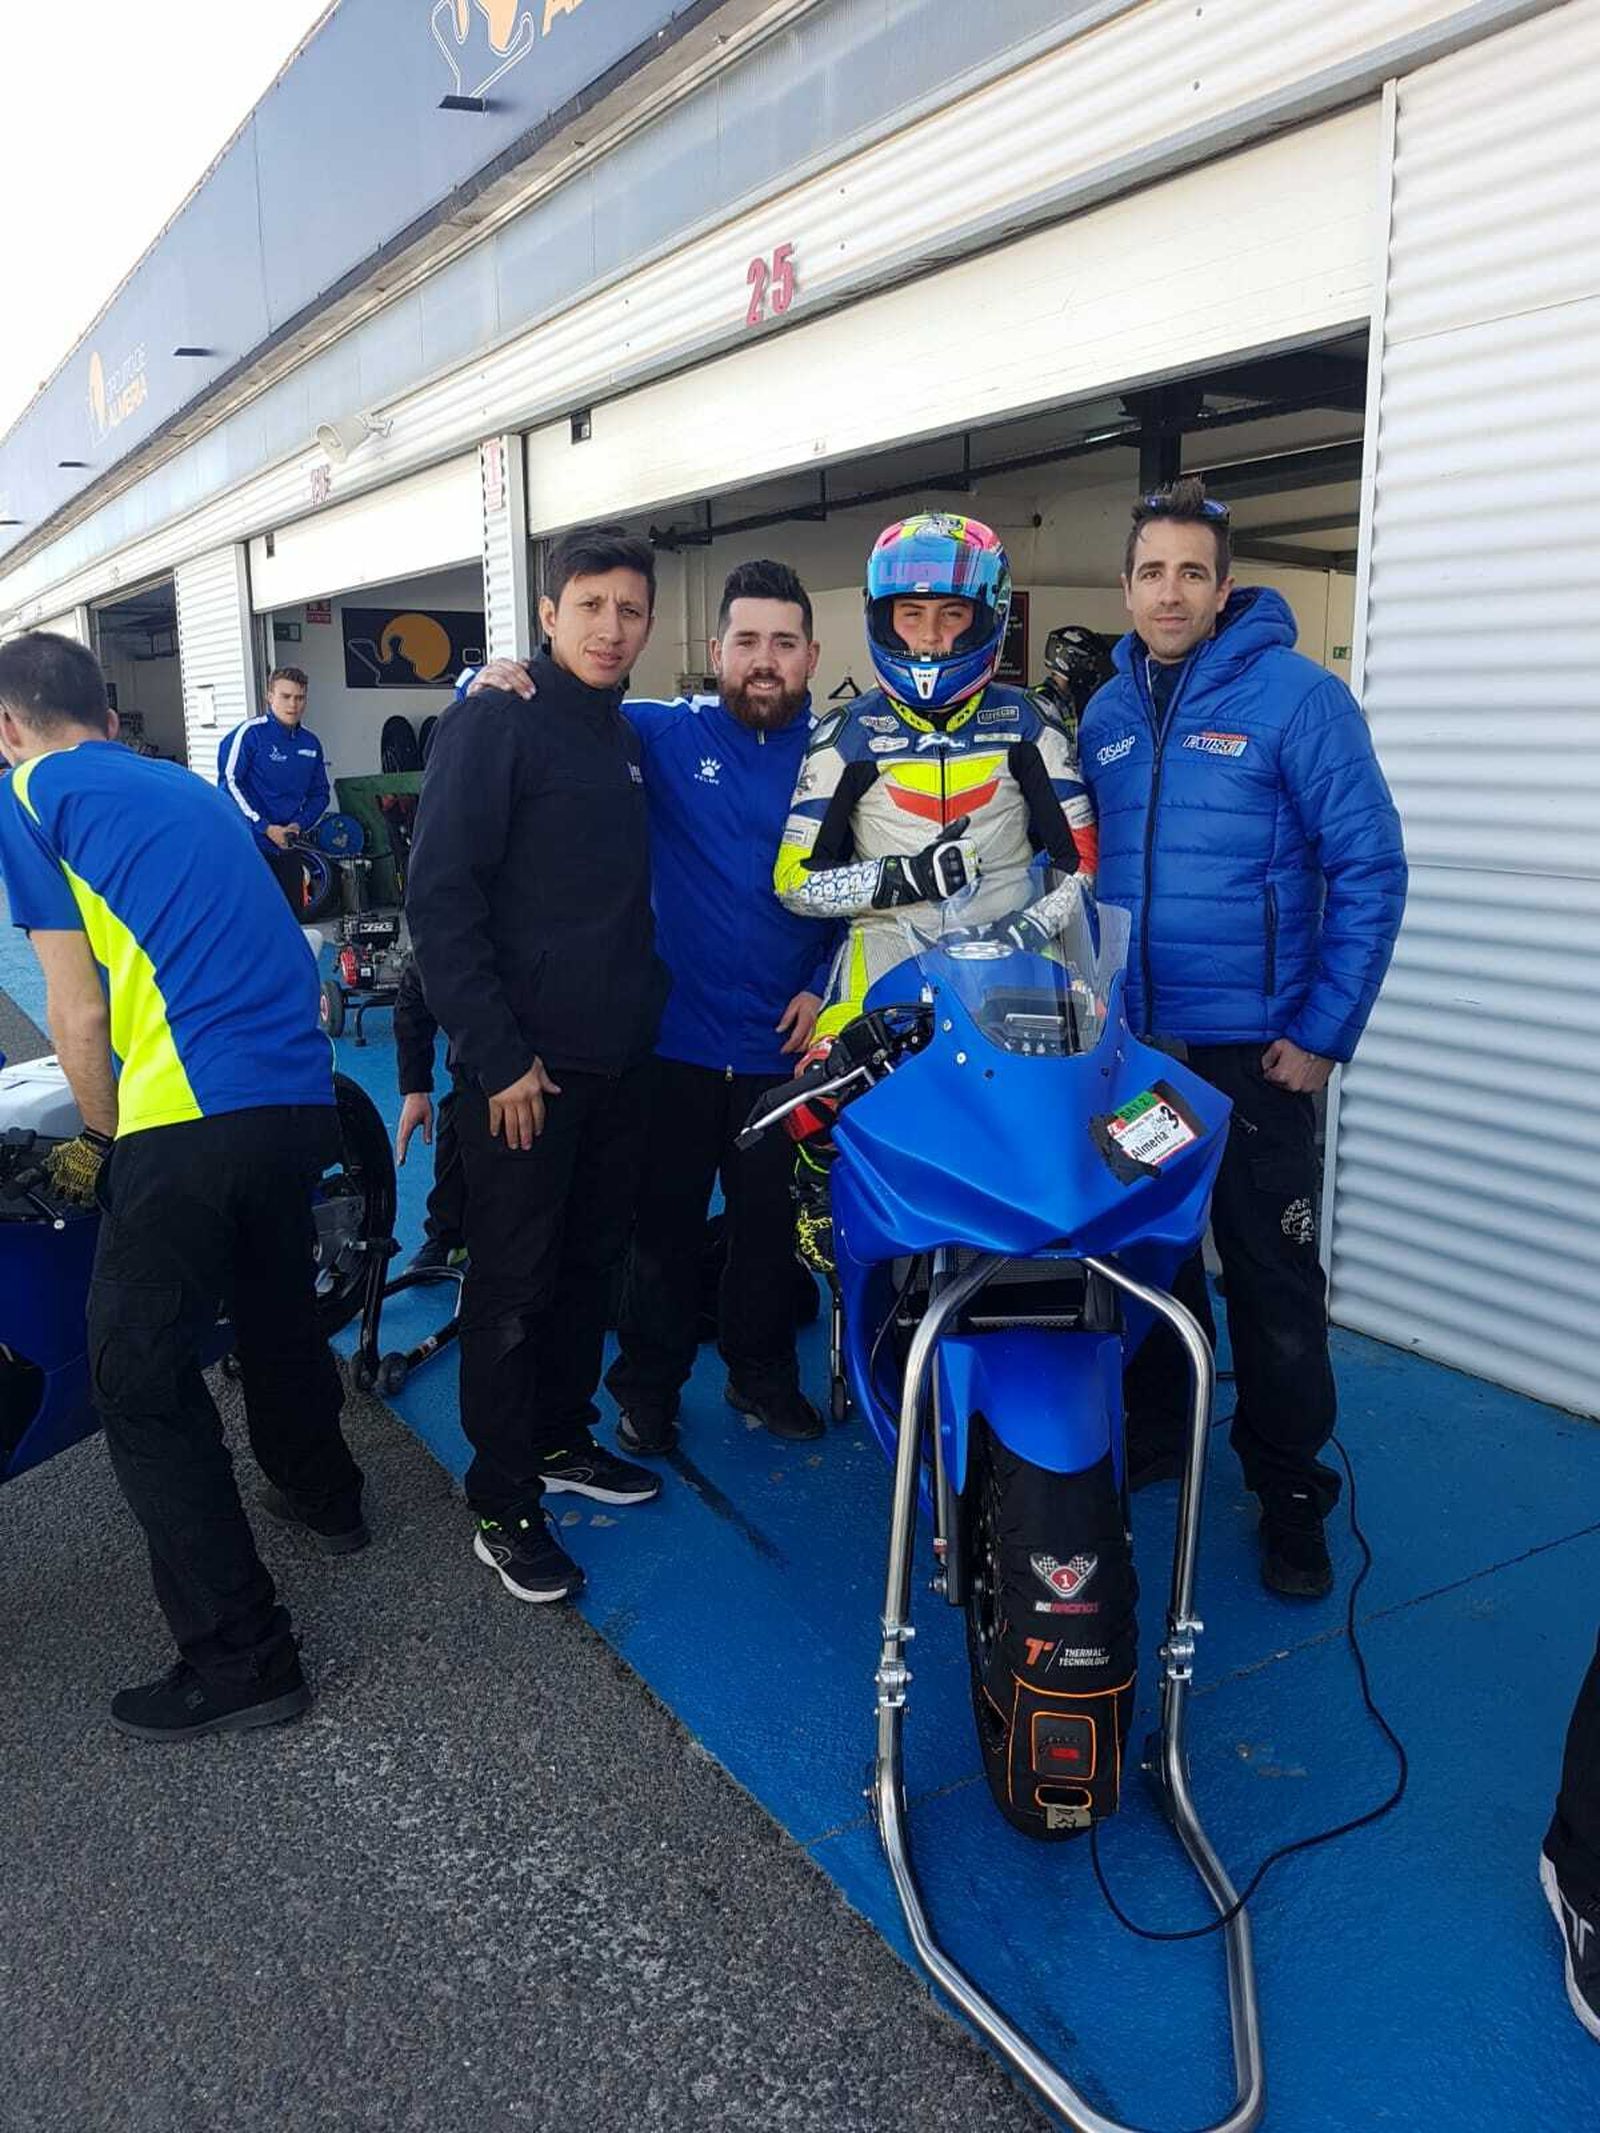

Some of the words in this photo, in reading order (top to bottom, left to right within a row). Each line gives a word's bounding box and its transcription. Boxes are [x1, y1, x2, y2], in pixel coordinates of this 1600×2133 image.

[746, 242, 794, 327] 25
[1160, 1105, 1179, 1129] 3
[1061, 1574, 1070, 1588] 1
[1064, 1647, 1103, 1658] THERMAL
[1058, 1656, 1110, 1667] TECHNOLOGY
